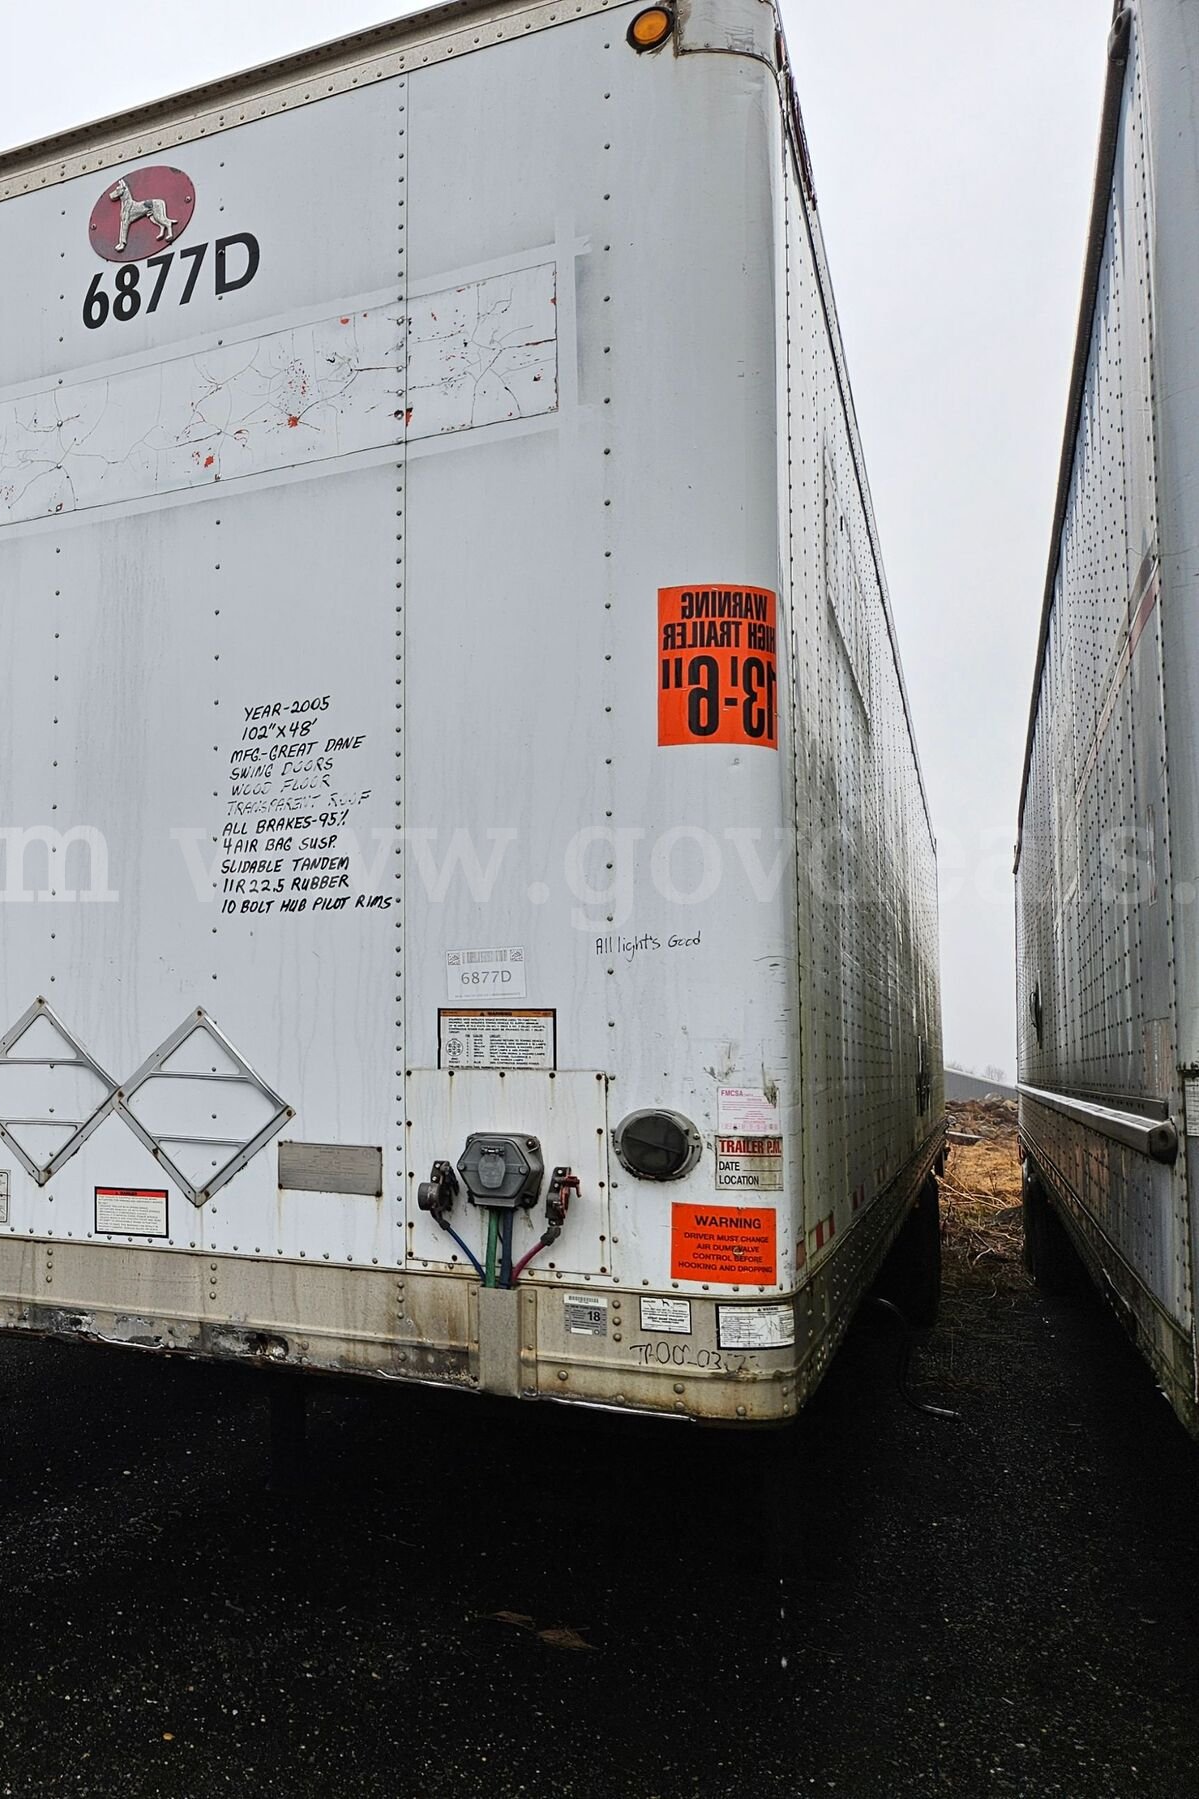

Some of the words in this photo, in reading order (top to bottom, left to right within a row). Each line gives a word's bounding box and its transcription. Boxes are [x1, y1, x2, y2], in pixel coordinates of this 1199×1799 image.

[82, 232, 260, 329] 6877D
[244, 695, 331, 722] YEAR-2005
[324, 735, 366, 752] DANE
[229, 763, 273, 780] SWING
[222, 822, 248, 836] ALL
[265, 838, 293, 851] BAG
[221, 858, 284, 874] SLIDABLE
[292, 856, 349, 872] TANDEM
[222, 899, 236, 914] 10
[240, 899, 275, 914] BOLT
[280, 898, 306, 913] HUB
[312, 896, 351, 911] PILOT
[355, 894, 392, 909] RIMS
[596, 936, 612, 955] All
[461, 970, 512, 985] 6877D
[720, 1089, 744, 1097] FMCSA
[719, 1140, 765, 1154] TRAILER
[719, 1161, 740, 1172] DATE
[719, 1175, 760, 1186] LOCATION
[694, 1215, 762, 1229] WARNING
[684, 1231, 715, 1241] DRIVER
[716, 1233, 739, 1242] MUST
[740, 1235, 769, 1244] CHANGE
[692, 1252, 733, 1262] CONTROL
[678, 1261, 717, 1271] HOOKING
[719, 1263, 736, 1272] AND
[737, 1265, 773, 1273] DROPPING
[587, 1311, 601, 1322] 18
